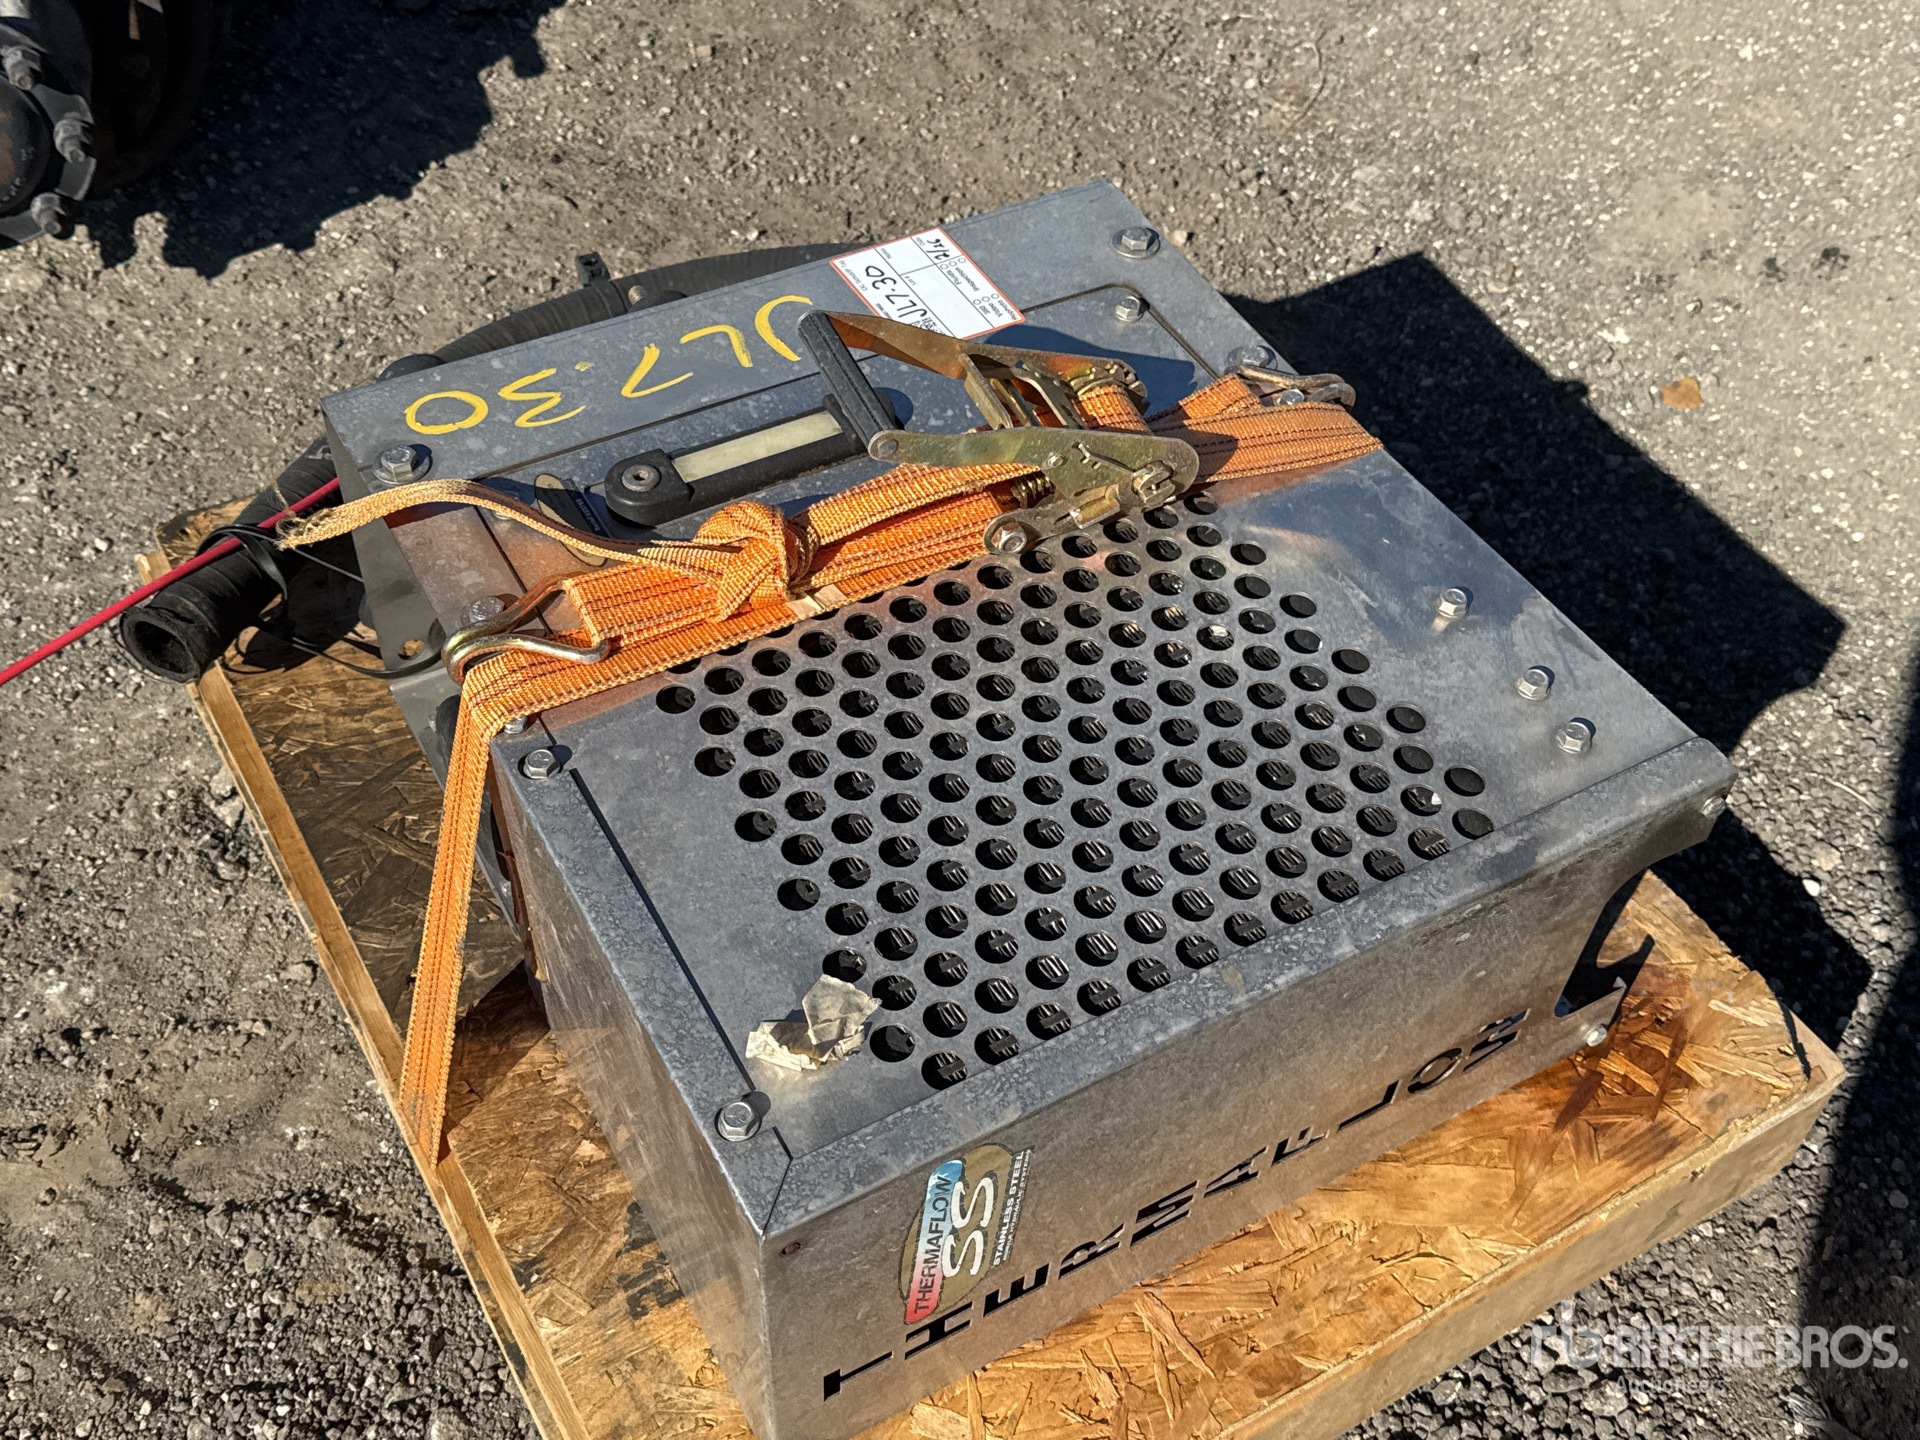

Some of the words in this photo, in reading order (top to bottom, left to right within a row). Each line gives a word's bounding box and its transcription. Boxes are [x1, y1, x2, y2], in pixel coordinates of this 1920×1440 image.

[946, 269, 963, 285] Fluids
[955, 267, 980, 292] Inspection
[989, 302, 1003, 318] Video
[403, 294, 813, 435] JL7.30
[914, 1175, 953, 1315] THERMAFLOW
[941, 1176, 995, 1278] SS
[993, 1196, 1015, 1267] STAINLESS
[1009, 1151, 1024, 1195] STEEL
